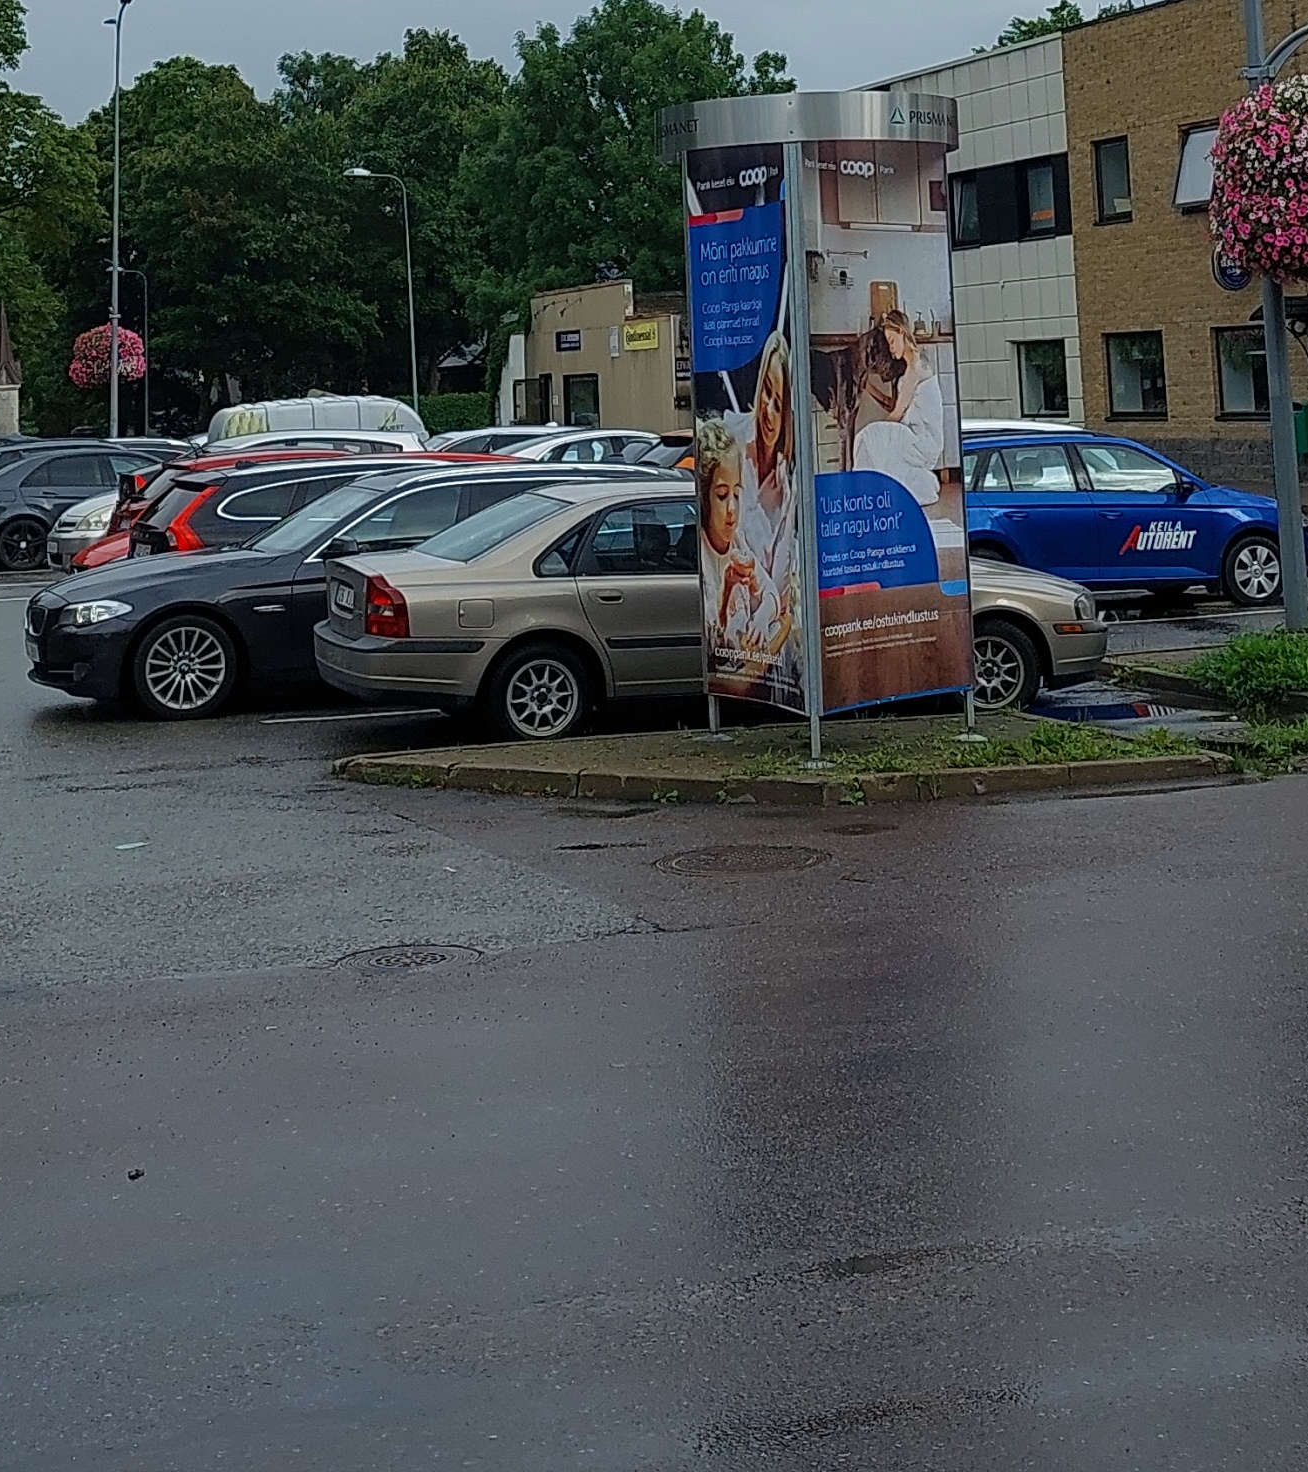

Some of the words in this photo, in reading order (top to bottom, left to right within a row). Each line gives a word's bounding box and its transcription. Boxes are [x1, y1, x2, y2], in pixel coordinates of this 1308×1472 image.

[739, 166, 767, 187] coop
[841, 160, 875, 178] coop
[700, 239, 727, 261] Mõni
[730, 234, 777, 263] pakkumine
[701, 270, 716, 286] on
[719, 263, 737, 284] eriti
[740, 263, 770, 285] magus
[843, 494, 874, 512] konts
[876, 490, 891, 509] oli
[821, 519, 841, 538] talle
[843, 518, 870, 538] nagu
[1149, 520, 1182, 533] KEILA
[1118, 524, 1197, 556] AUTORENT
[824, 609, 939, 638] cooppank.ee/ostukindlustus
